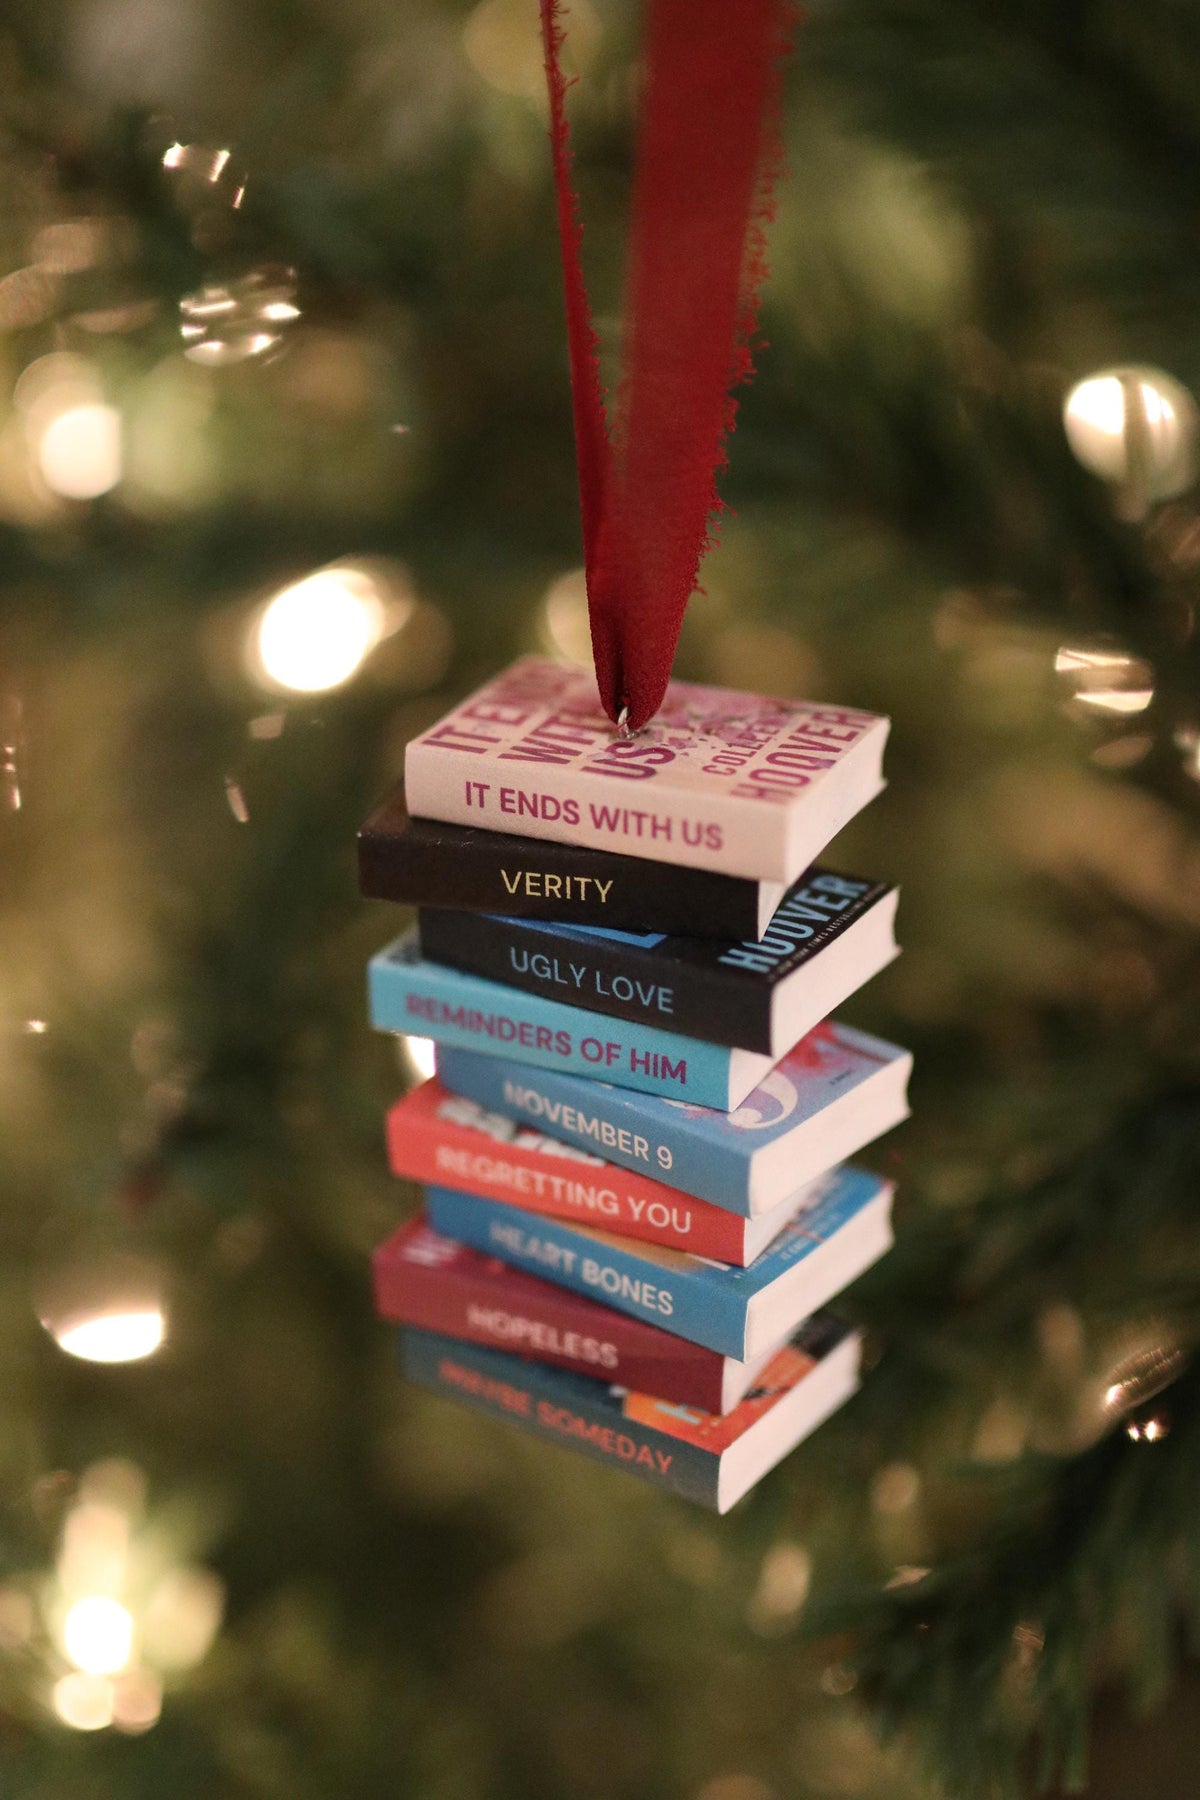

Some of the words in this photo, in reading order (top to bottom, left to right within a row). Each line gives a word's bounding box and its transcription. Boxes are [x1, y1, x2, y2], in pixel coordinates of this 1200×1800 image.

[420, 725, 502, 755] IT
[580, 741, 677, 780] US
[729, 710, 878, 805] HOOVER
[465, 780, 490, 809] IT
[500, 786, 580, 826] ENDS
[588, 803, 672, 843] WITH
[682, 821, 724, 852] US
[500, 869, 614, 904] VERITY
[717, 874, 869, 974] HOOVER
[509, 946, 587, 993] UGLY
[596, 975, 675, 1014] LOVE
[405, 993, 572, 1057] REMINDERS
[580, 1037, 622, 1067] OF
[630, 1046, 688, 1085] HIM
[504, 1081, 648, 1161] NOVEMBER
[656, 1144, 674, 1170] 9
[434, 1145, 619, 1217] REGRETTING
[627, 1197, 692, 1233] YOU
[489, 1219, 577, 1275] HEART
[582, 1258, 674, 1316] BONES
[466, 1304, 619, 1369] HOPELESS
[536, 1400, 673, 1474] SOMEDAY
